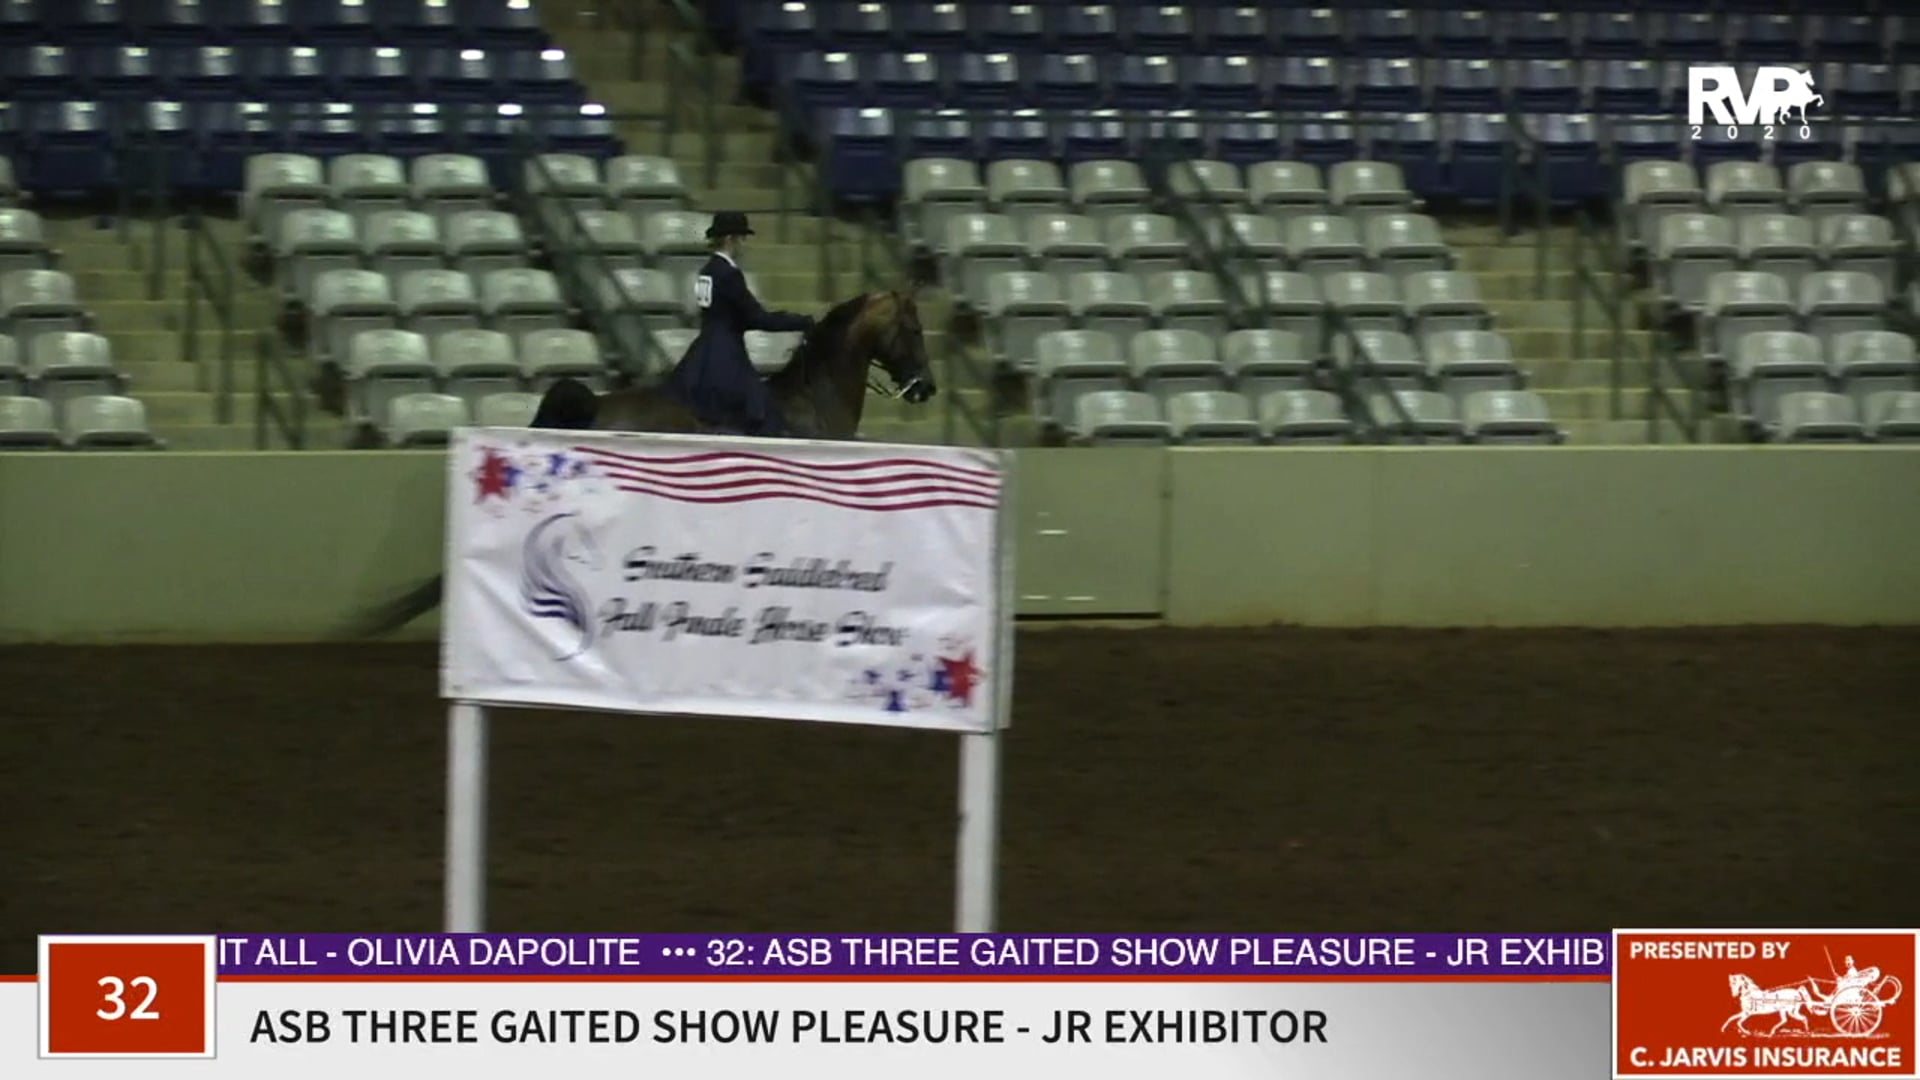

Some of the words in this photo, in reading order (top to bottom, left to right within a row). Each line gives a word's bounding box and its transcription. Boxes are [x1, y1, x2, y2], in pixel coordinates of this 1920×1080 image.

[623, 545, 737, 583] Southern
[744, 552, 894, 592] Saddlebred
[599, 597, 657, 638] Fall
[749, 606, 829, 644] Horse
[837, 610, 908, 647] Show
